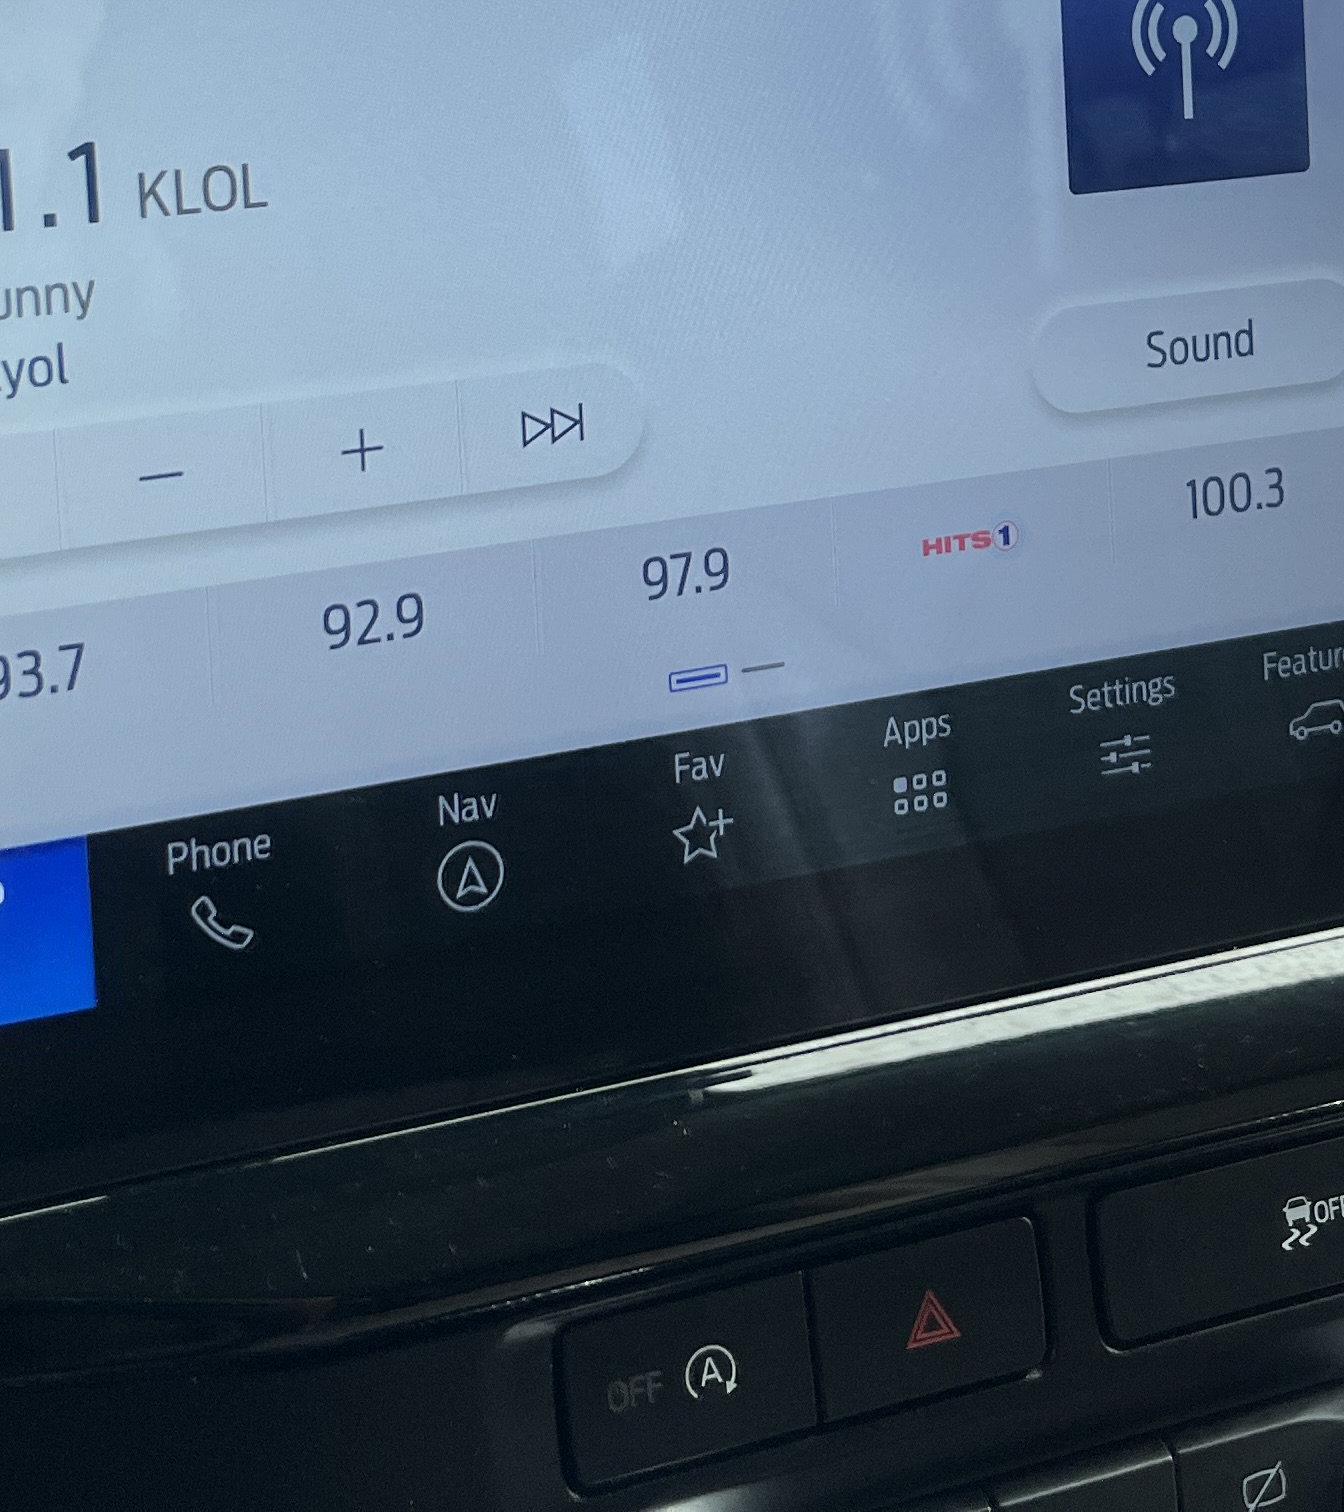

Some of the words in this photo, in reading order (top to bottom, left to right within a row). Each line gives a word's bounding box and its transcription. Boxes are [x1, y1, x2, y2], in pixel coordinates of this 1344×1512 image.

[136, 162, 269, 219] KLOL
[1145, 317, 1255, 369] Sound
[322, 591, 426, 651] 92.9
[641, 545, 731, 602] 97.9
[1185, 466, 1286, 520] 100.3
[1068, 670, 1178, 717] Settings
[883, 710, 953, 754] Apps
[672, 749, 727, 785] Fav
[437, 791, 500, 828] Nav
[166, 832, 274, 877] Phone
[607, 1370, 663, 1413] OFF
